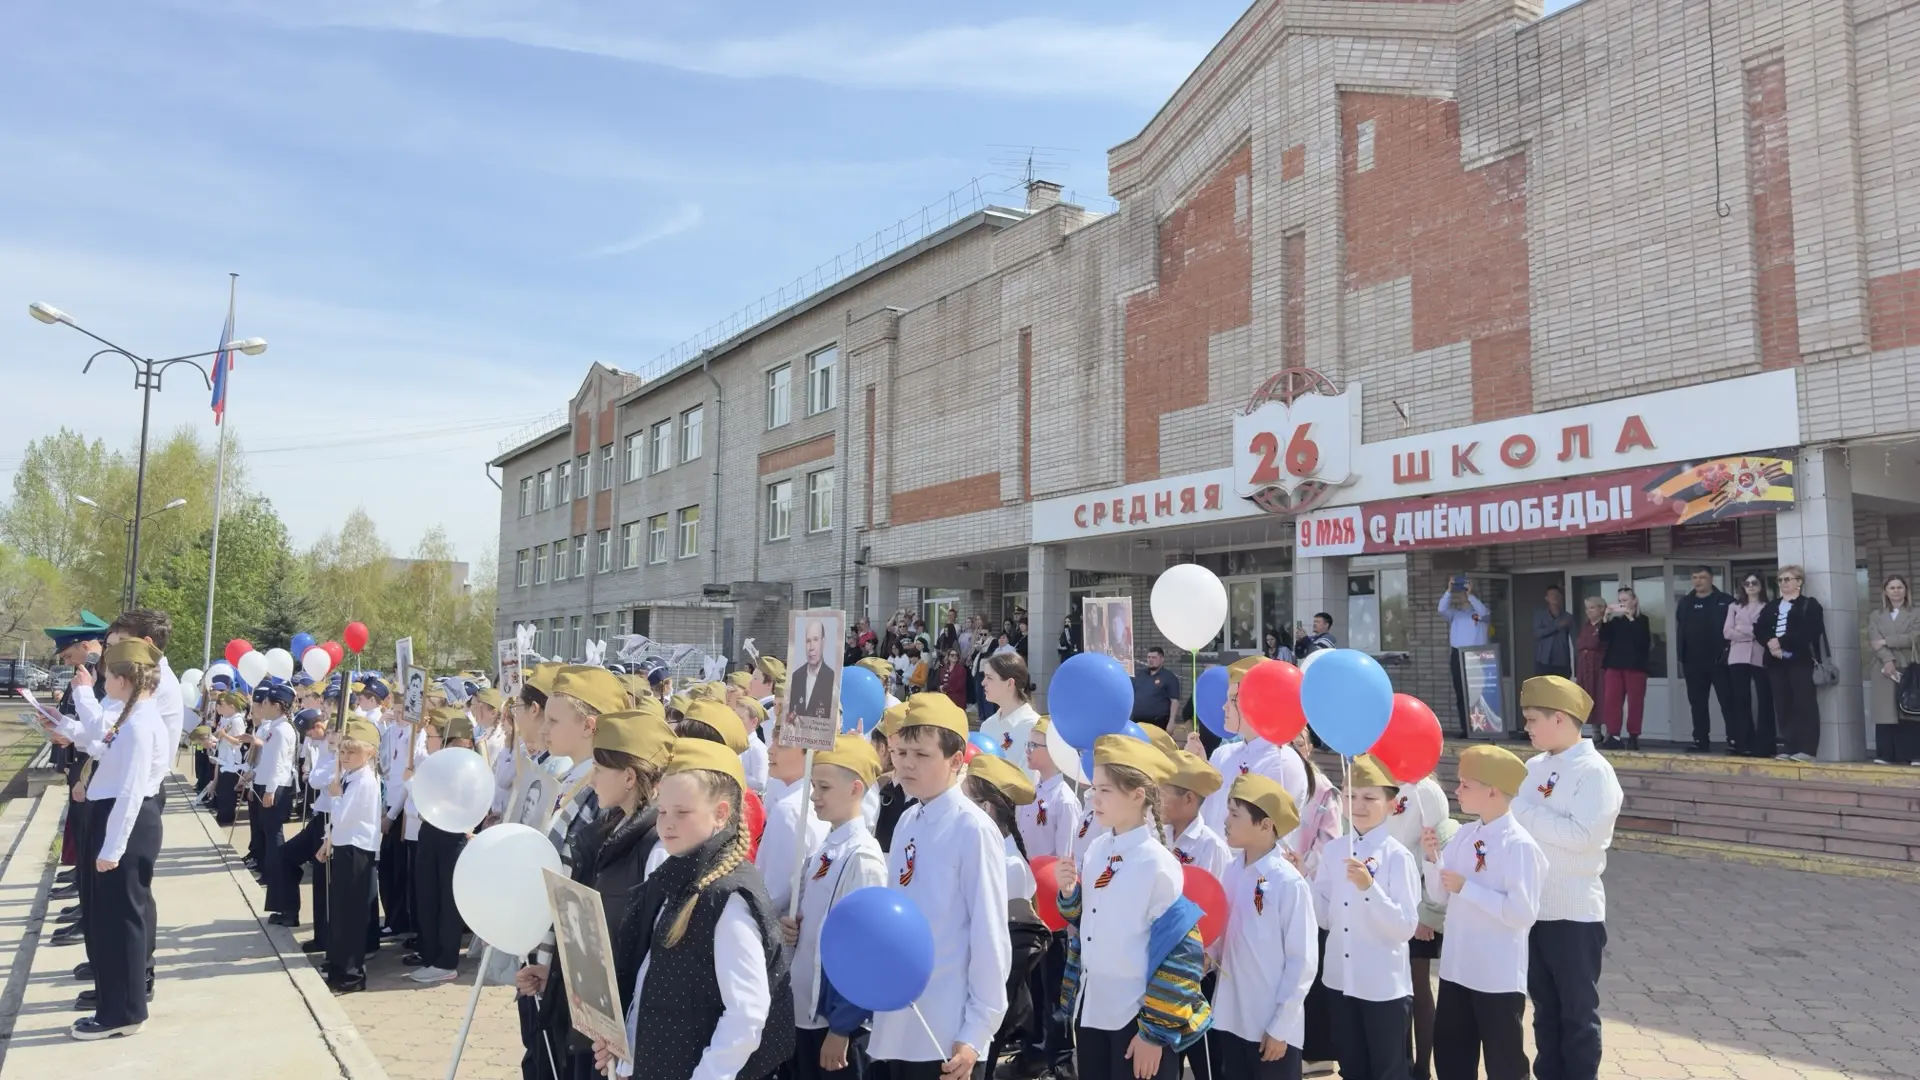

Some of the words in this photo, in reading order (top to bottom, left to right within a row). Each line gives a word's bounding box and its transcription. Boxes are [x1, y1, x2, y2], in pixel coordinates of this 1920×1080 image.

[1074, 483, 1221, 529] СРЕДНЯЯ
[1248, 422, 1320, 485] 26
[1393, 415, 1656, 484] ШКОЛА
[1301, 519, 1312, 548] 9
[1315, 516, 1356, 546] МАЯ
[1369, 514, 1387, 544] С
[1393, 503, 1472, 546] ДНЁМ
[1479, 485, 1633, 532] ПОБЕДЫ!
